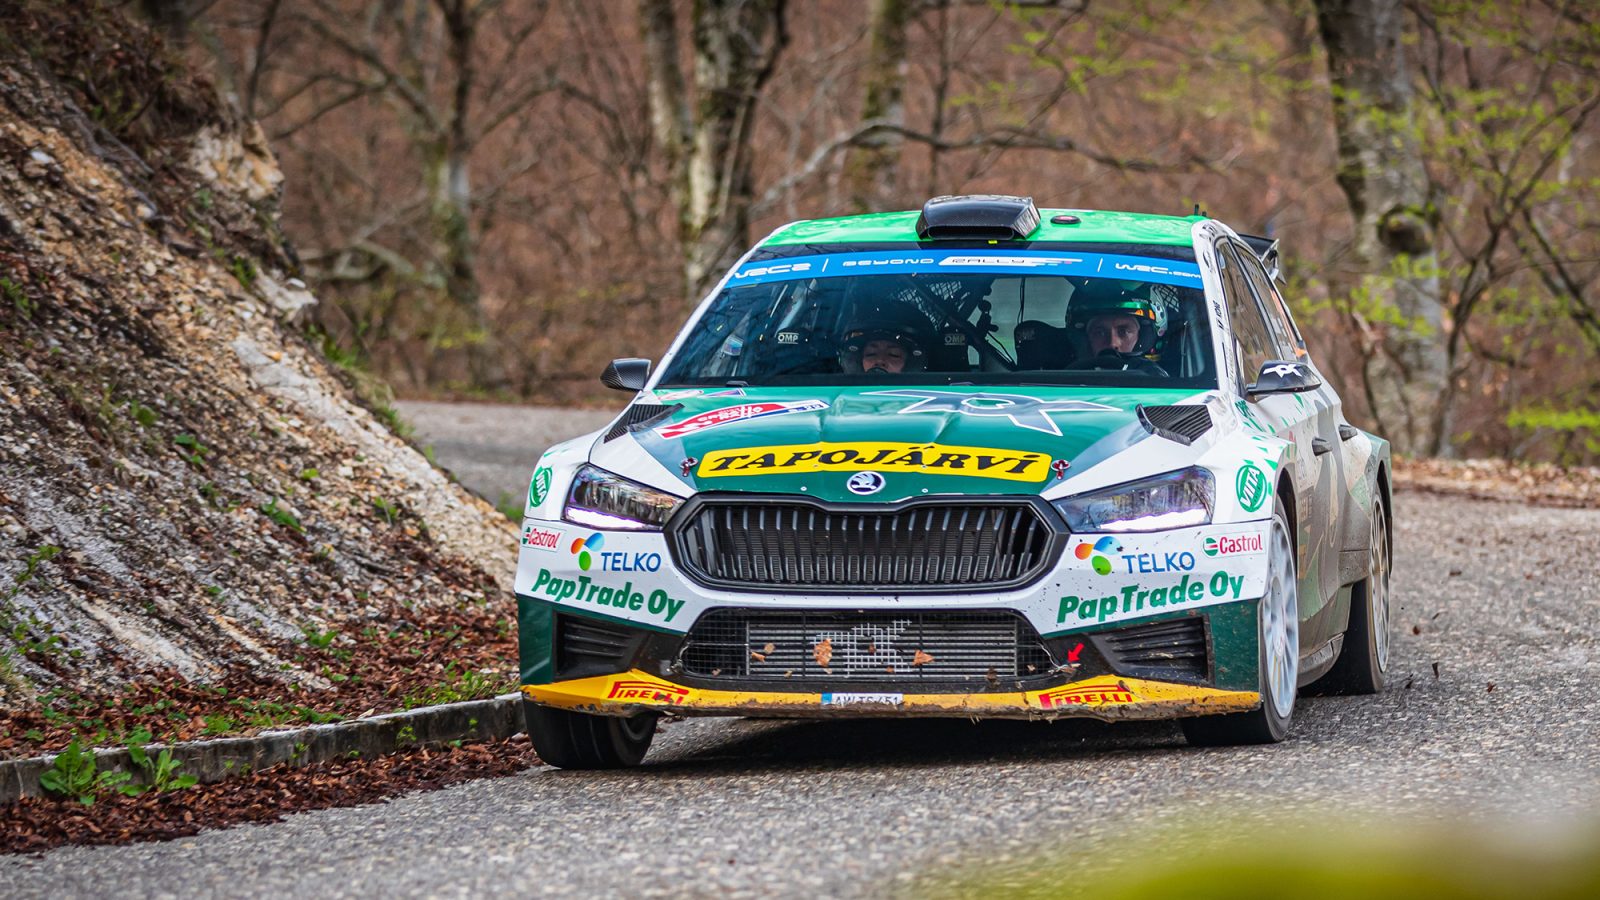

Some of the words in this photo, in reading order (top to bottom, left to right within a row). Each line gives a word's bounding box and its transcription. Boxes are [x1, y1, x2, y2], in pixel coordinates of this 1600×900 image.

[843, 258, 934, 267] BEYOND
[777, 333, 799, 343] OMP
[944, 334, 966, 344] OMP
[709, 445, 1040, 474] TAPOJÄRVI
[1239, 467, 1261, 508] VITA
[528, 528, 560, 549] Castrol
[1219, 534, 1263, 554] Castrol
[601, 552, 662, 572] TELKO
[1121, 551, 1196, 574] TELKO
[531, 568, 644, 611] PapTrade
[647, 588, 686, 623] Oy
[1057, 574, 1204, 623] PapTrade
[1209, 570, 1245, 599] Oy
[607, 680, 690, 705] PIRELLI
[1038, 684, 1133, 710] PIRELLI
